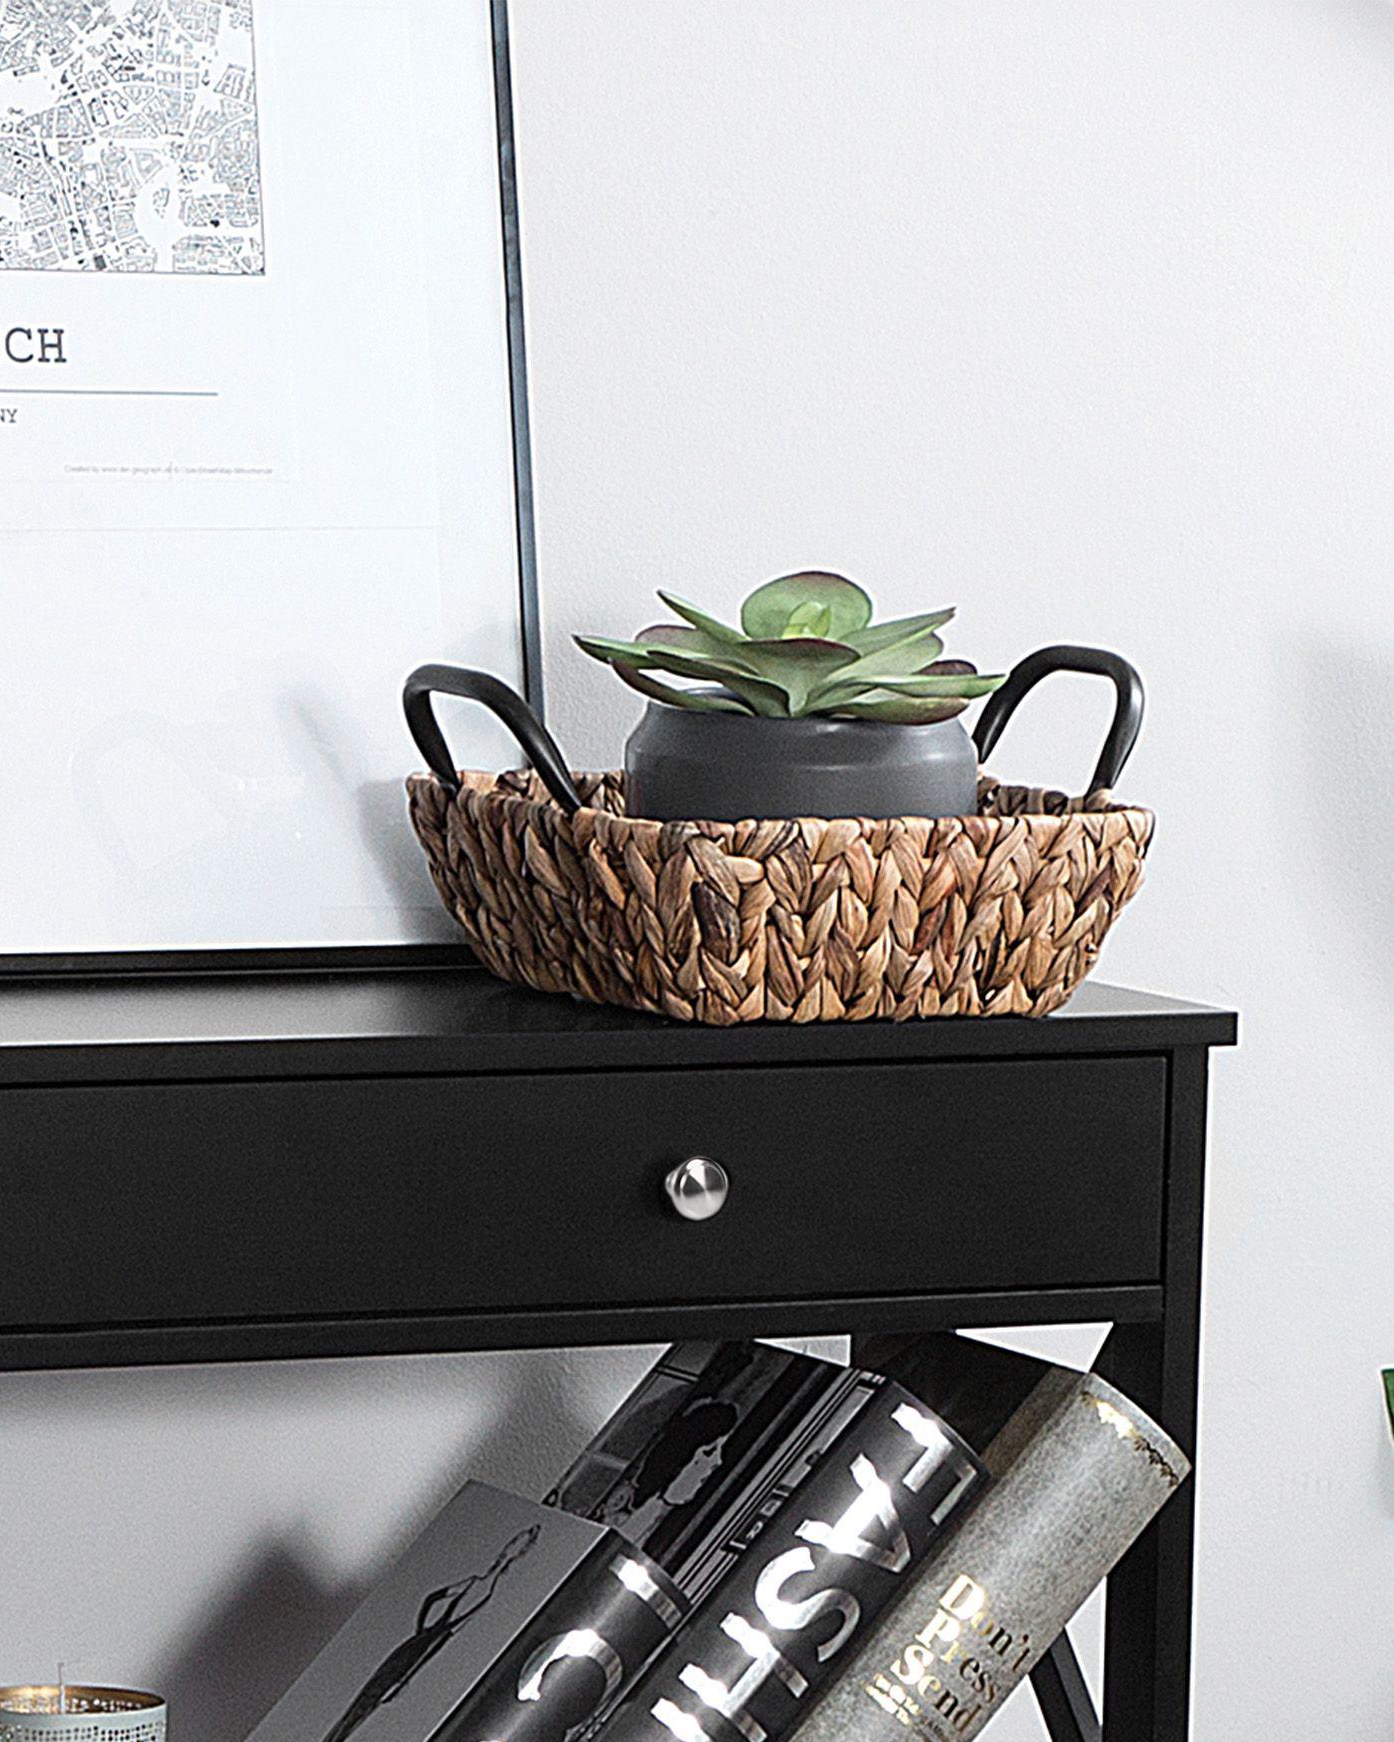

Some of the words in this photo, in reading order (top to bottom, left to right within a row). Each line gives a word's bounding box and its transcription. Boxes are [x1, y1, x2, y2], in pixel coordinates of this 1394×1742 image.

[916, 1608, 996, 1702] Press
[939, 1573, 1030, 1672] Don't
[890, 1644, 982, 1732] Send
